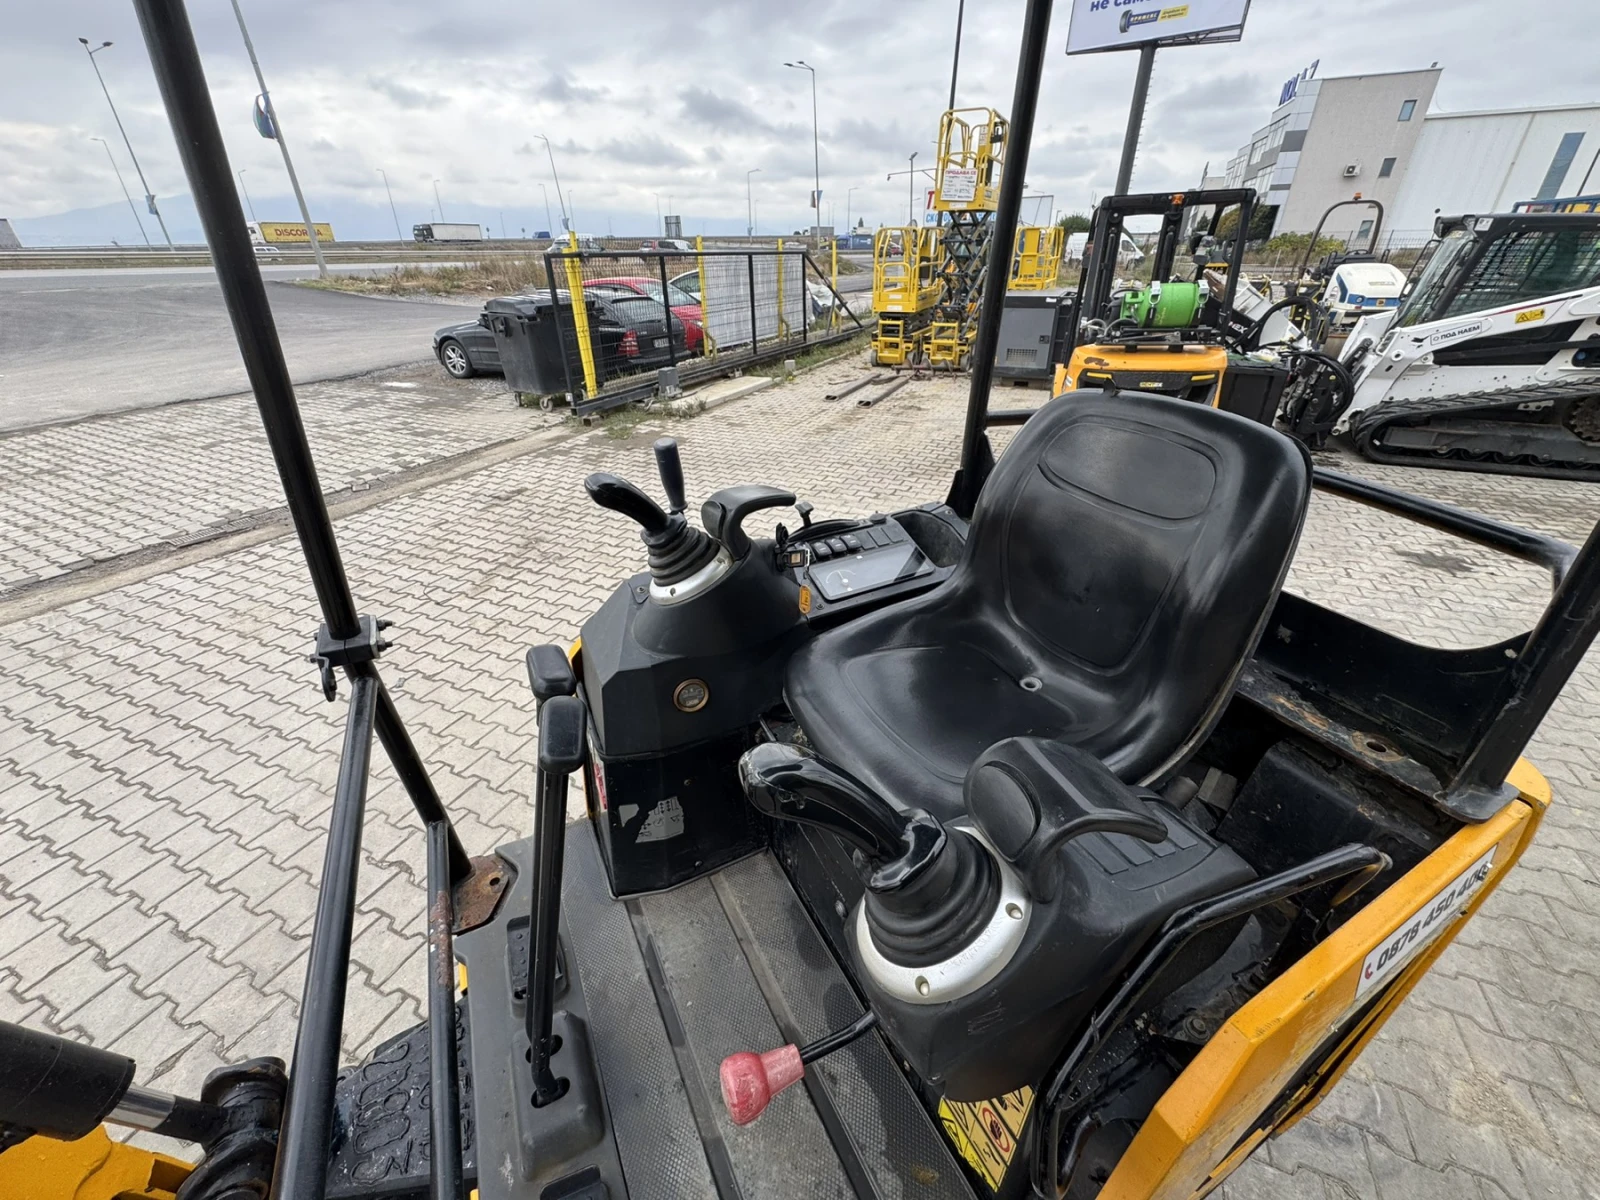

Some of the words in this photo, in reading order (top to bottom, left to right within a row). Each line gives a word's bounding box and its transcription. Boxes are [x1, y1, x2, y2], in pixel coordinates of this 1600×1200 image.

[1090, 0, 1108, 12] не
[1440, 331, 1457, 340] ПОД
[1457, 325, 1480, 335] НАЕМ
[1376, 920, 1422, 971] 0878
[1422, 889, 1456, 929] 450
